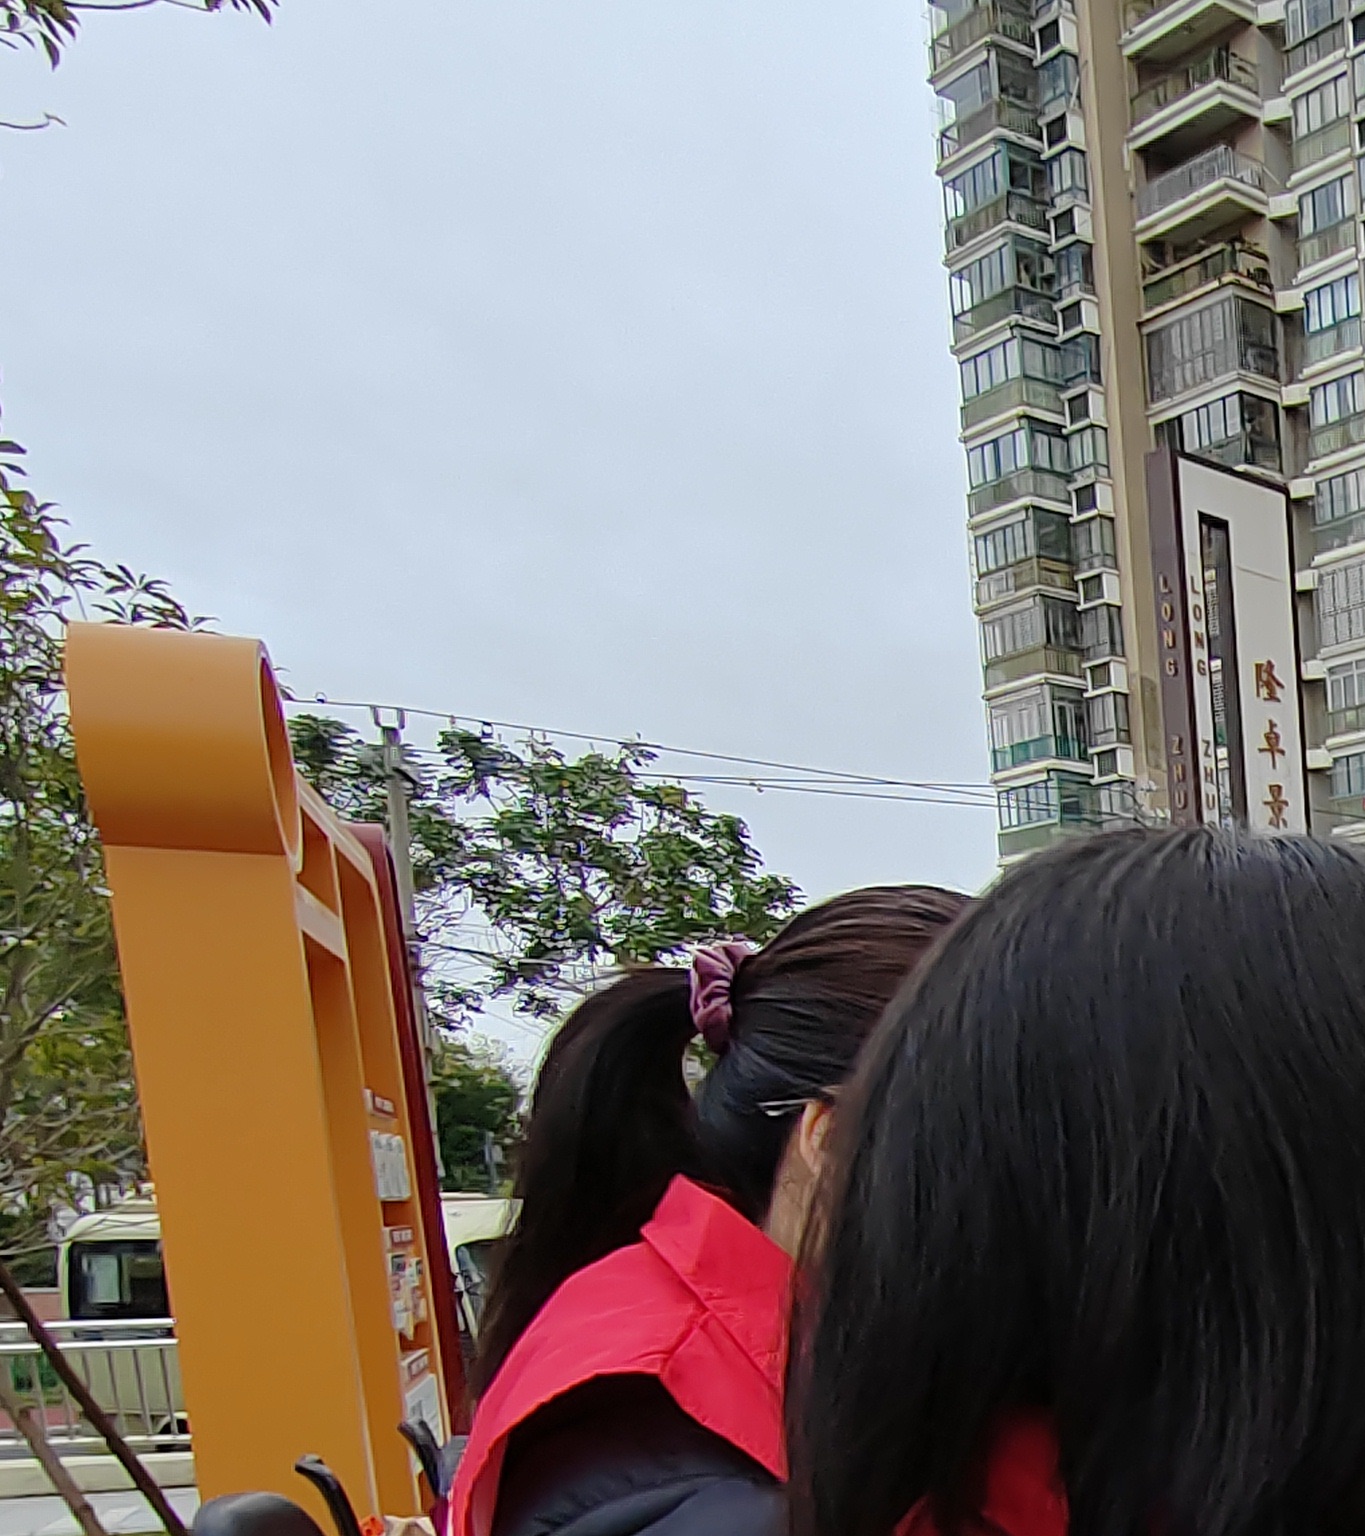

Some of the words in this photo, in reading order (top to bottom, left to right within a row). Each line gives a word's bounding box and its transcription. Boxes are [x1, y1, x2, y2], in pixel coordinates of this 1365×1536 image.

[1159, 575, 1179, 678] LONG
[1190, 575, 1207, 677] LONG
[1254, 659, 1289, 830] 隆卓景
